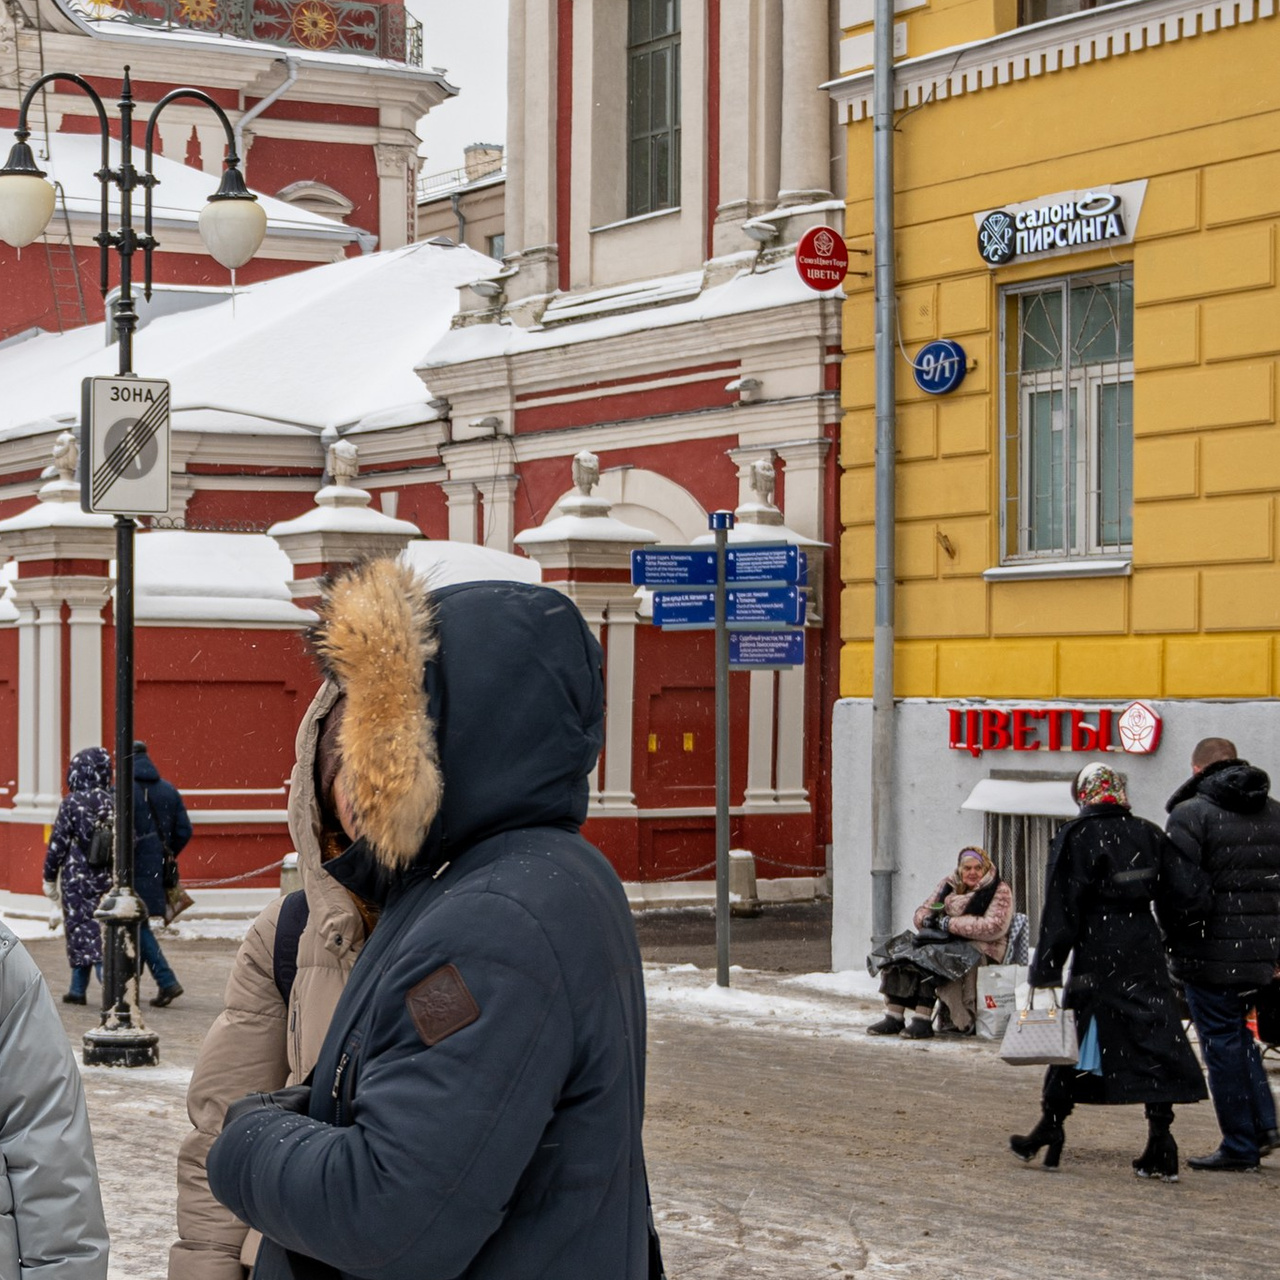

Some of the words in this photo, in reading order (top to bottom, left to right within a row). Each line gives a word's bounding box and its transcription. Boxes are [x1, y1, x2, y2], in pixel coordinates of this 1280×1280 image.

[1015, 201, 1074, 230] салон
[1015, 213, 1120, 255] ПИРСИНГА
[807, 268, 840, 281] ЦВЕТЫ
[922, 351, 951, 383] 9/1
[110, 386, 155, 404] ЗОНА
[947, 708, 1113, 758] ЦВЕТЫ
